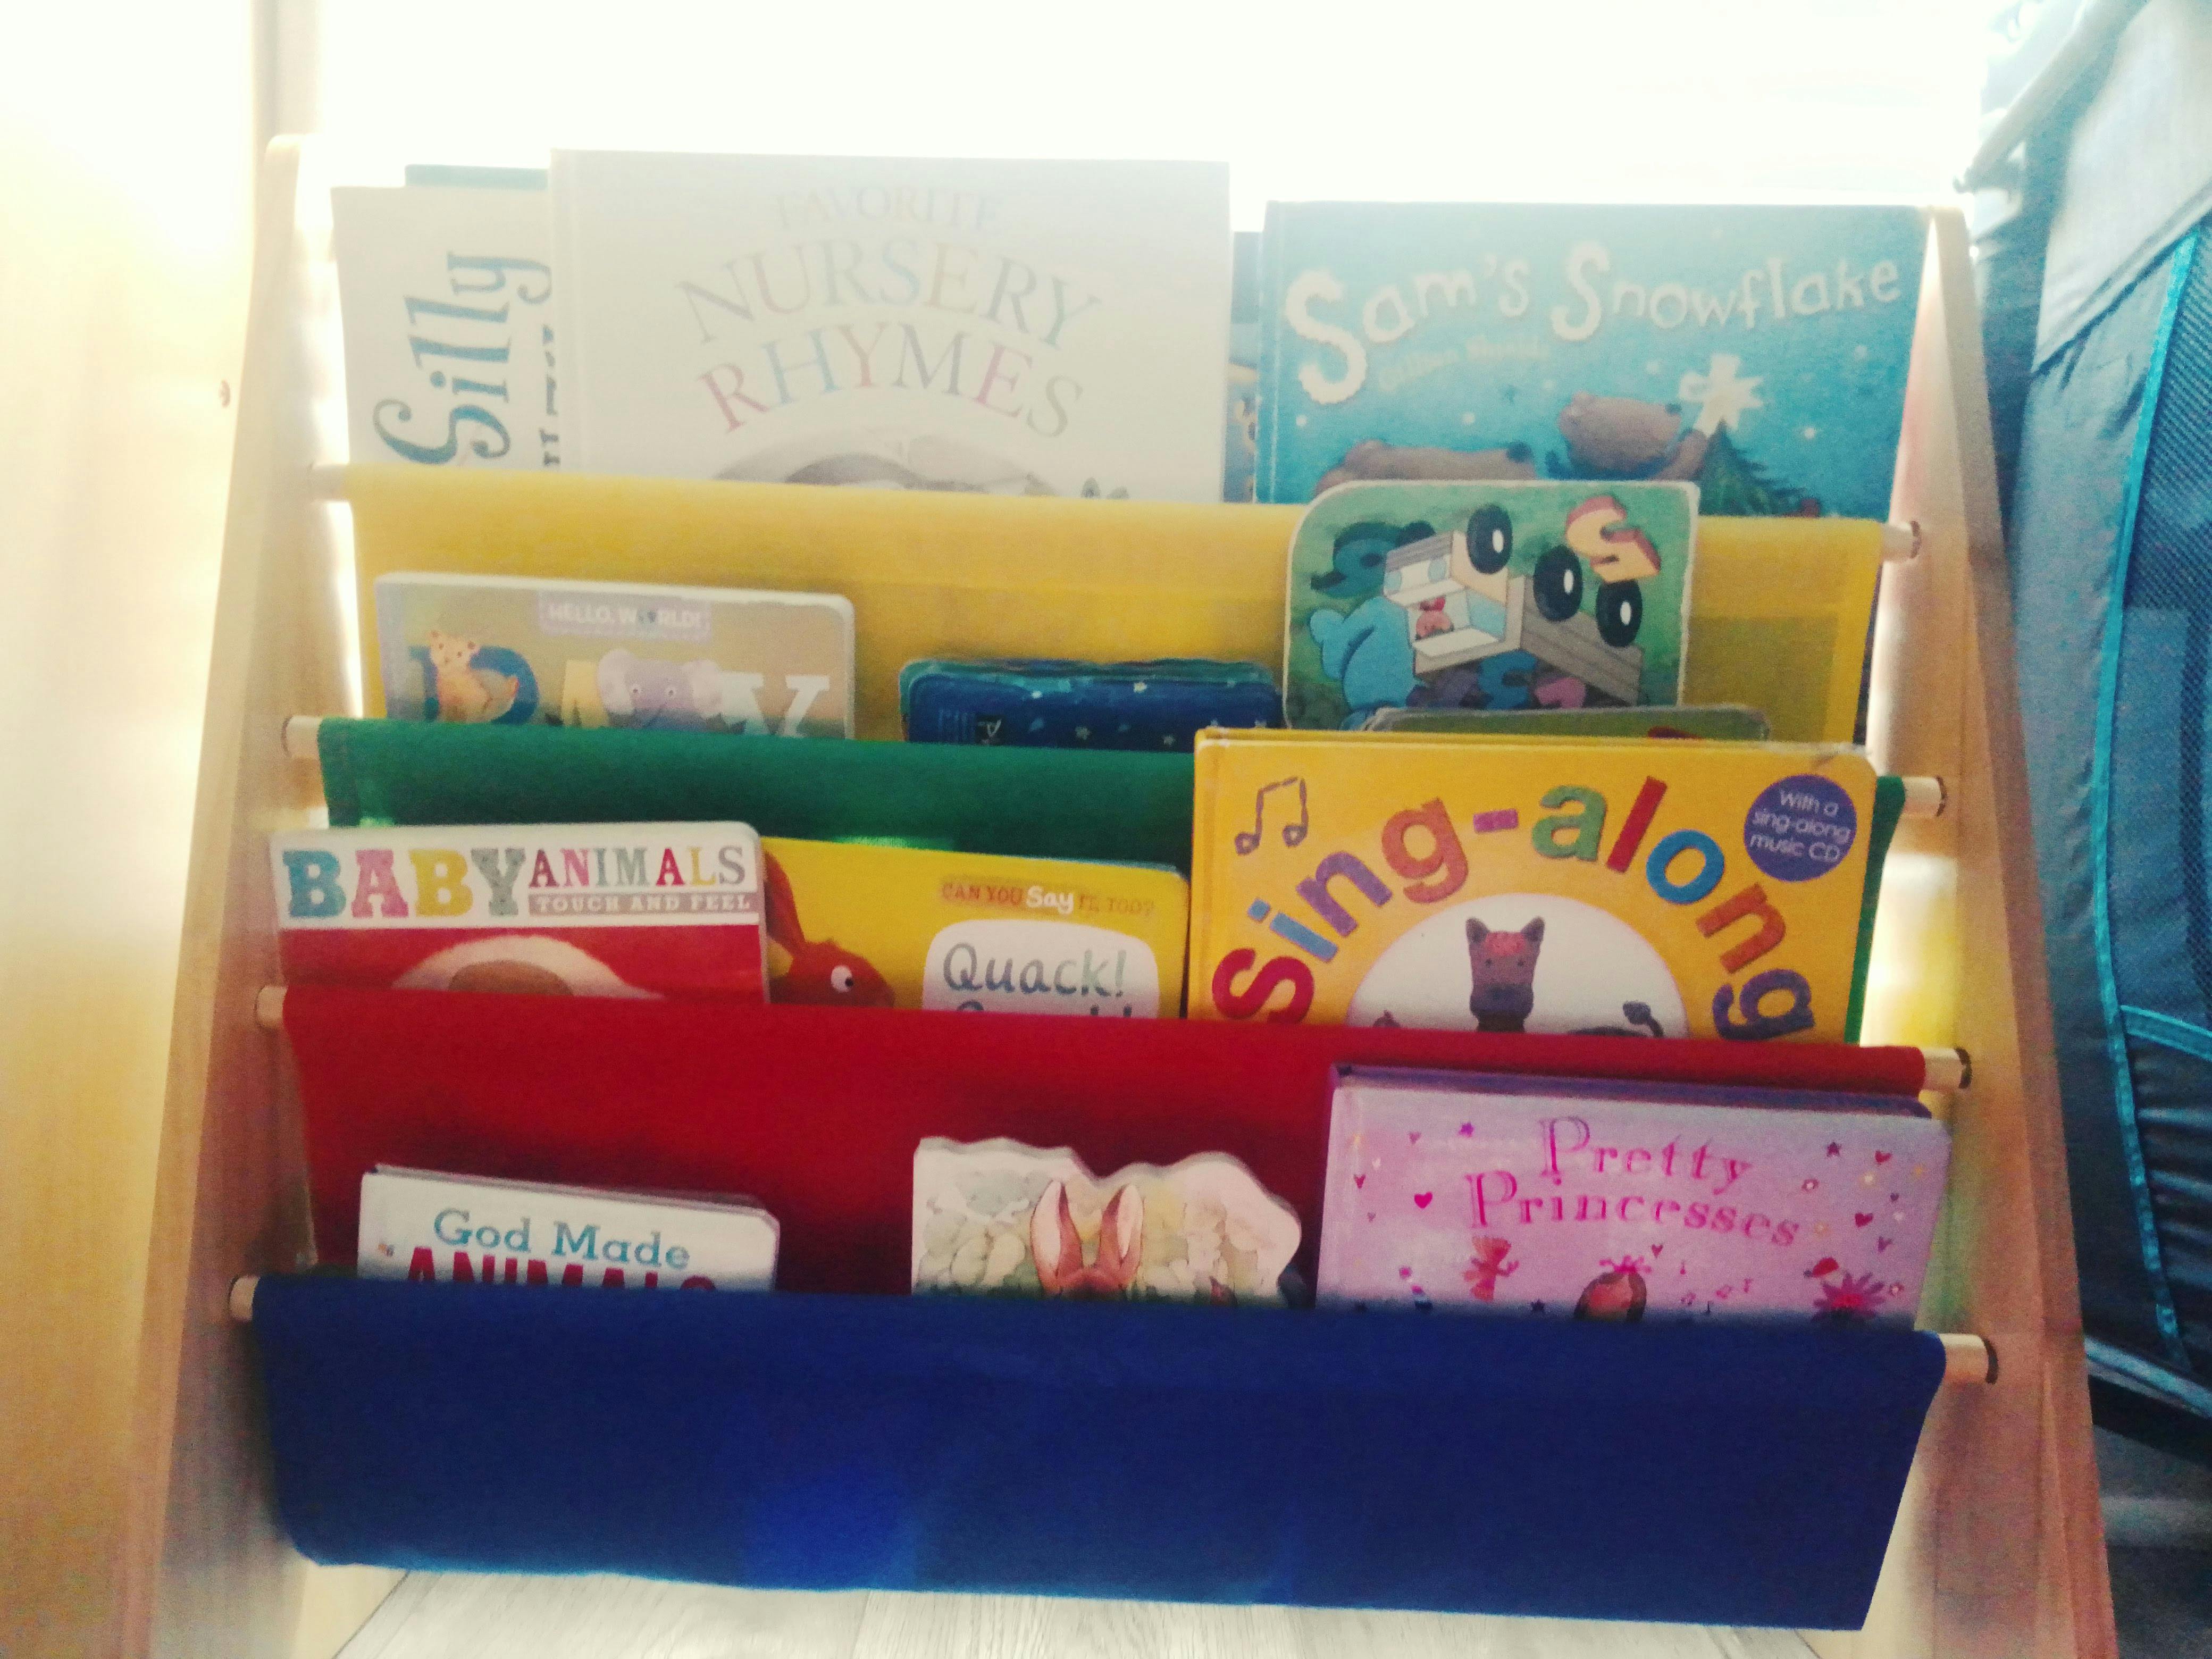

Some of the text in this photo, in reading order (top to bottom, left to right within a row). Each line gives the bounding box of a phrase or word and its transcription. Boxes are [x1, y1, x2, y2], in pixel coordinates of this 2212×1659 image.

[676, 238, 1102, 351] NURSERY
[1285, 254, 1530, 405] Sam's
[1550, 241, 1902, 342] Snowflake
[373, 250, 552, 466] Silly
[696, 322, 1084, 438] RHYMES
[1753, 808, 1851, 845] sing-along
[1781, 789, 1839, 817] With a
[282, 844, 745, 919] BABY ANIMALS
[1750, 834, 1840, 862] music CD
[536, 893, 750, 912] TOUCH AND FEEL
[942, 883, 981, 901] CAN
[985, 885, 1024, 906] YOU
[1026, 885, 1074, 915] Say
[943, 942, 1127, 998] Quack!
[1538, 1115, 1756, 1197] Pretty
[433, 1208, 690, 1270] God Made
[1464, 1170, 1801, 1247] Princesses
